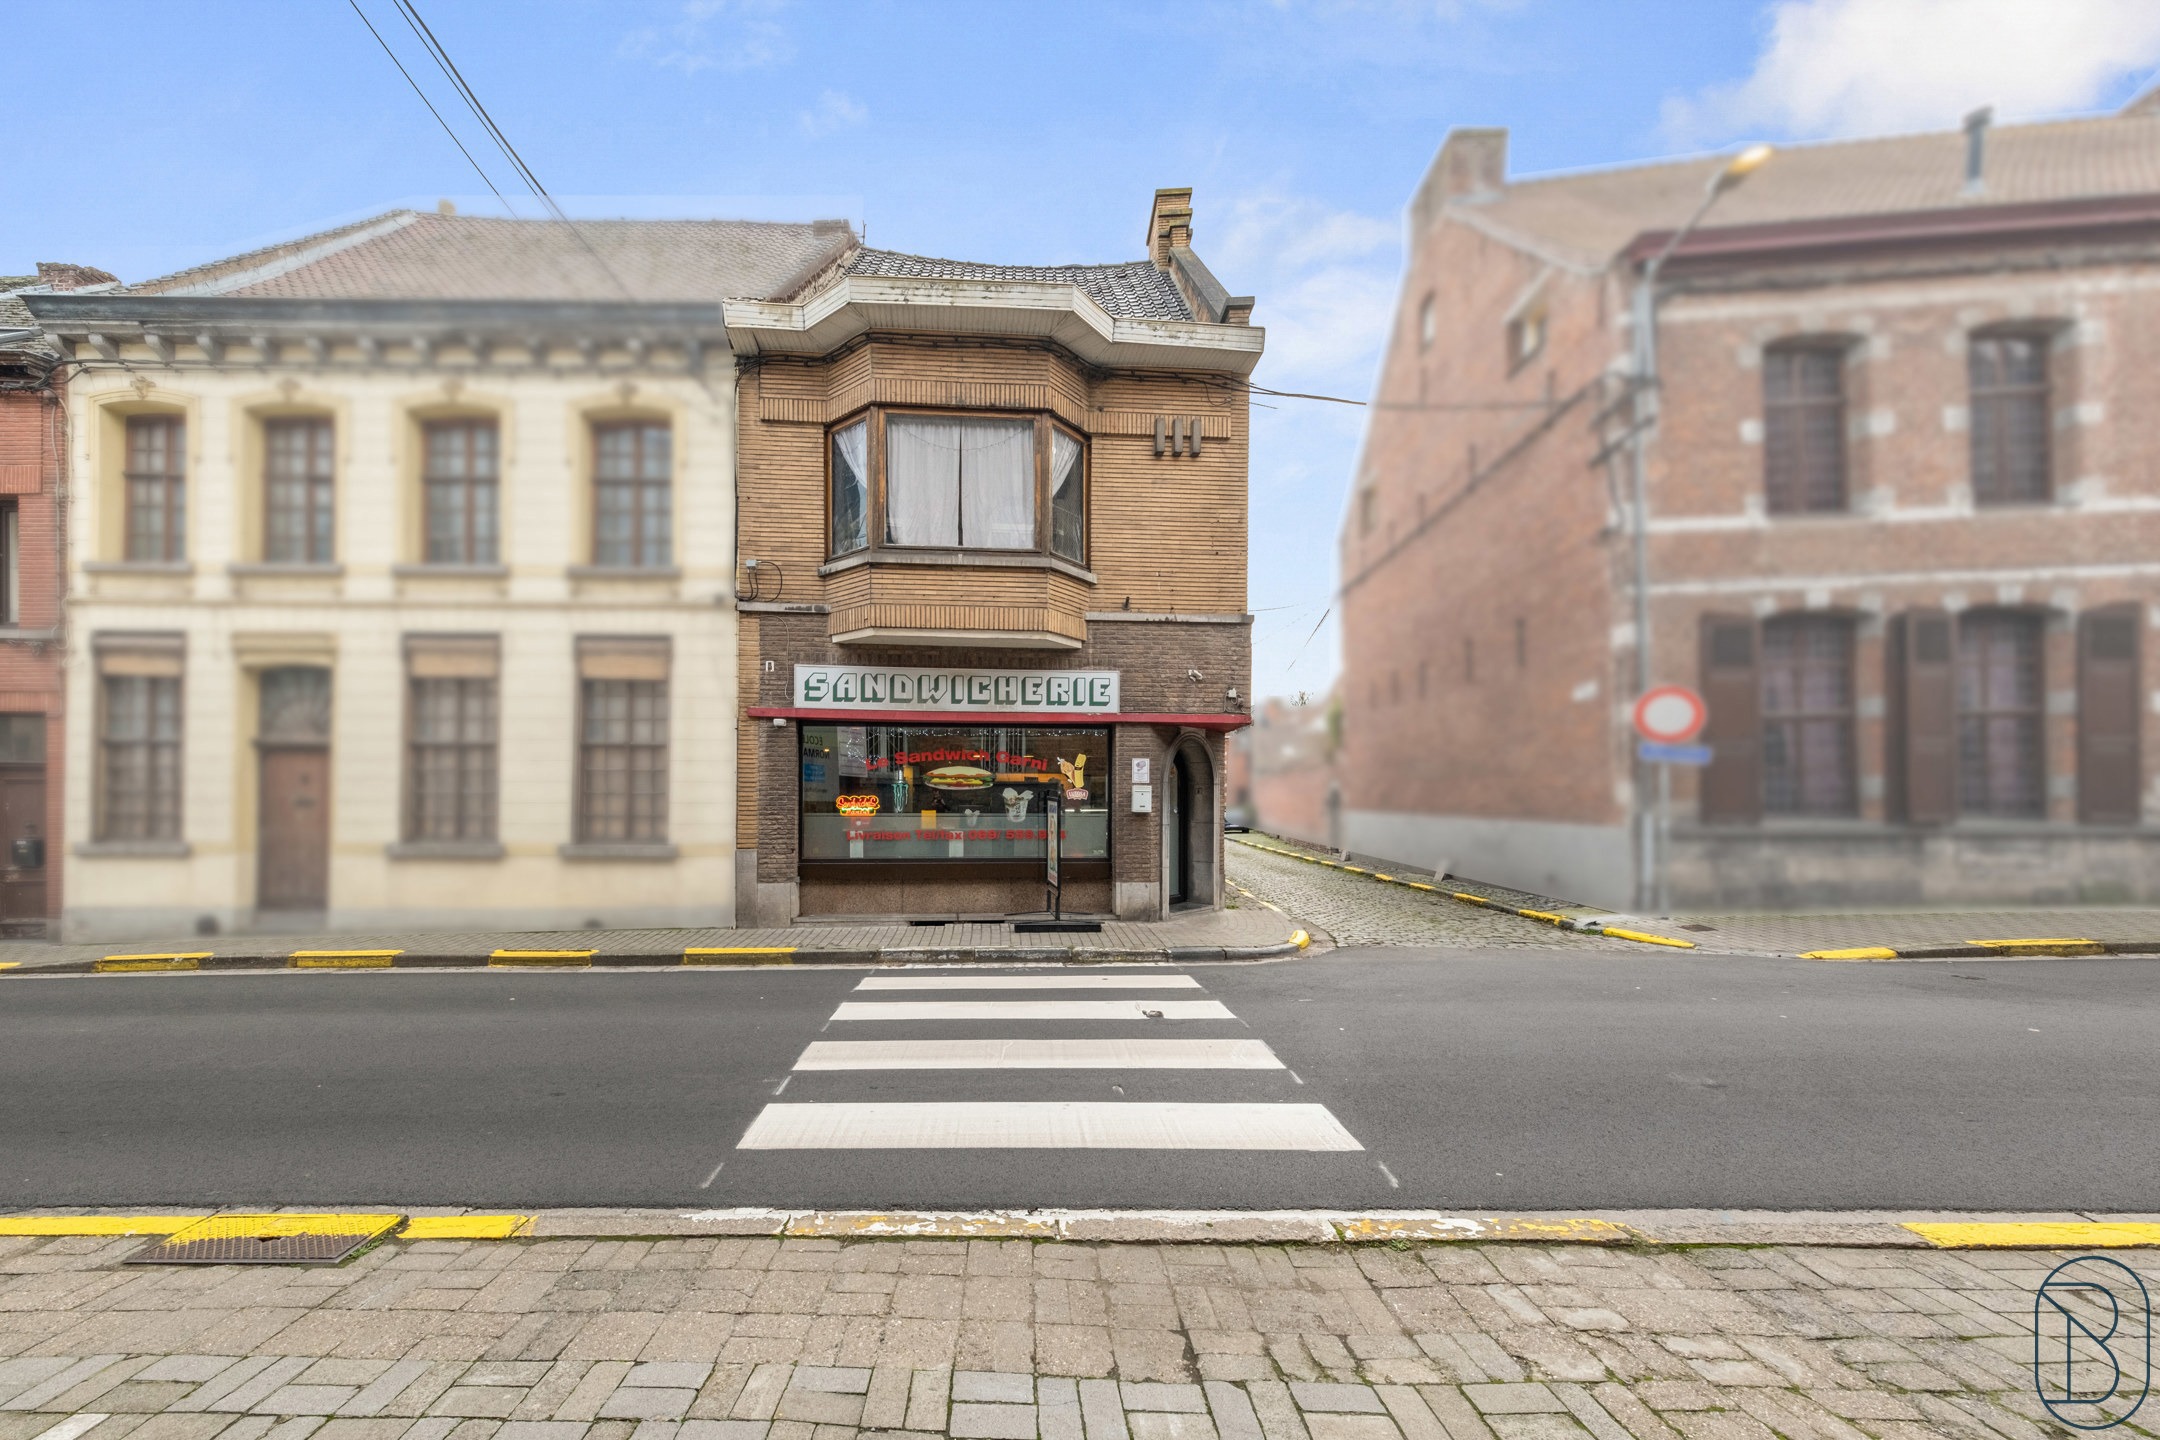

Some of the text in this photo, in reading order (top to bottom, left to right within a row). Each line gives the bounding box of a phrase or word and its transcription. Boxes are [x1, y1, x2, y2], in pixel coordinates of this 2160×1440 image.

[804, 671, 1111, 706] SANDWICHERIE
[865, 748, 1048, 771] Le Sandwich Garni
[846, 829, 911, 841] Livraison
